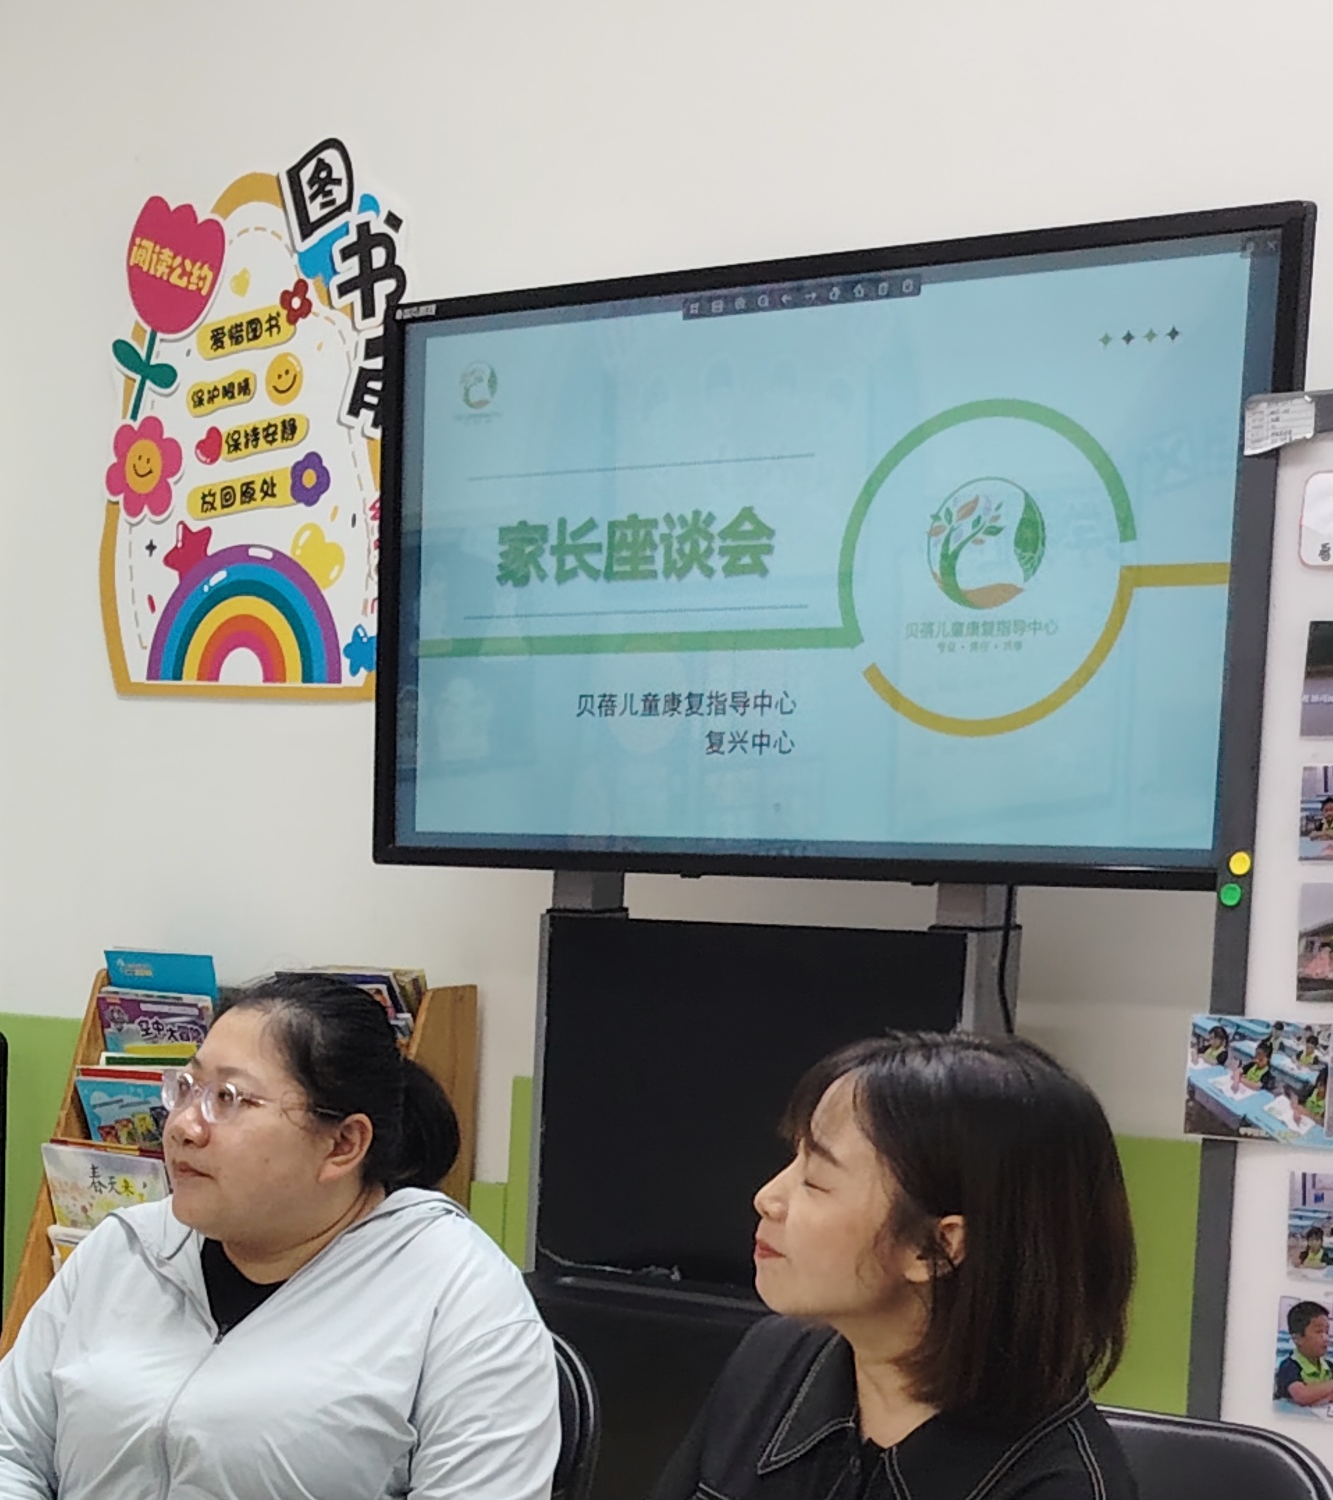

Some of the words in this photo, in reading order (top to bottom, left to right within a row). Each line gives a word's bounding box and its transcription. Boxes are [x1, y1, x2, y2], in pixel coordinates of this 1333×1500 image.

[129, 237, 213, 296] 阅读公约
[210, 312, 281, 351] 爱惜图书
[191, 377, 252, 408] 保护眼睛
[225, 418, 297, 453] 保持安静
[200, 477, 277, 513] 放回原处
[496, 506, 776, 588] 家长座谈会
[575, 689, 798, 718] 贝蓓儿童康复指导中心
[705, 729, 796, 756] 复兴中心
